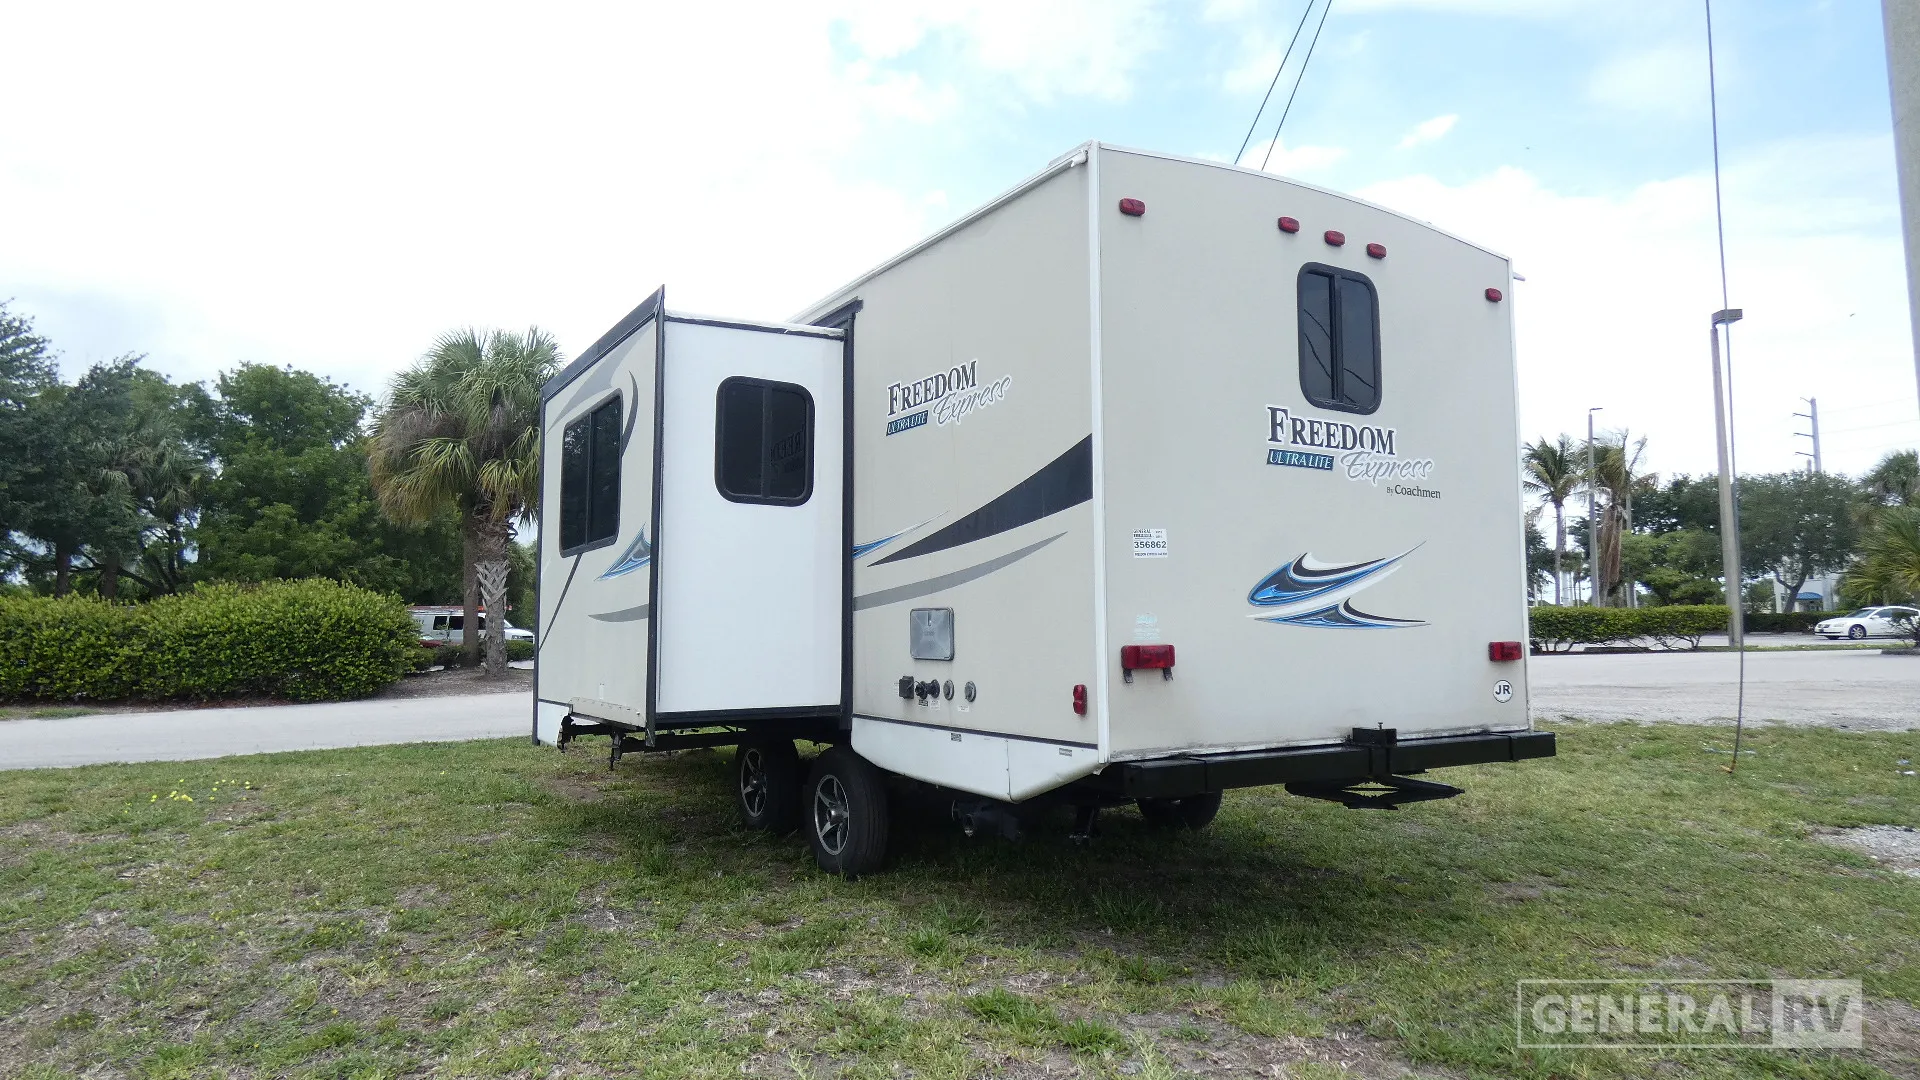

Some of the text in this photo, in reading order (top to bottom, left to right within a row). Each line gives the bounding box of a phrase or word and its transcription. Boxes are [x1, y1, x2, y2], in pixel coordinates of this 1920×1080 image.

[887, 360, 977, 416] FREEDOM
[933, 376, 1011, 425] Express
[1267, 406, 1395, 456] FREEDOM
[1340, 450, 1433, 485] Express
[1394, 484, 1441, 499] Coachmen
[1133, 540, 1167, 549] 356862
[1495, 684, 1511, 695] JR
